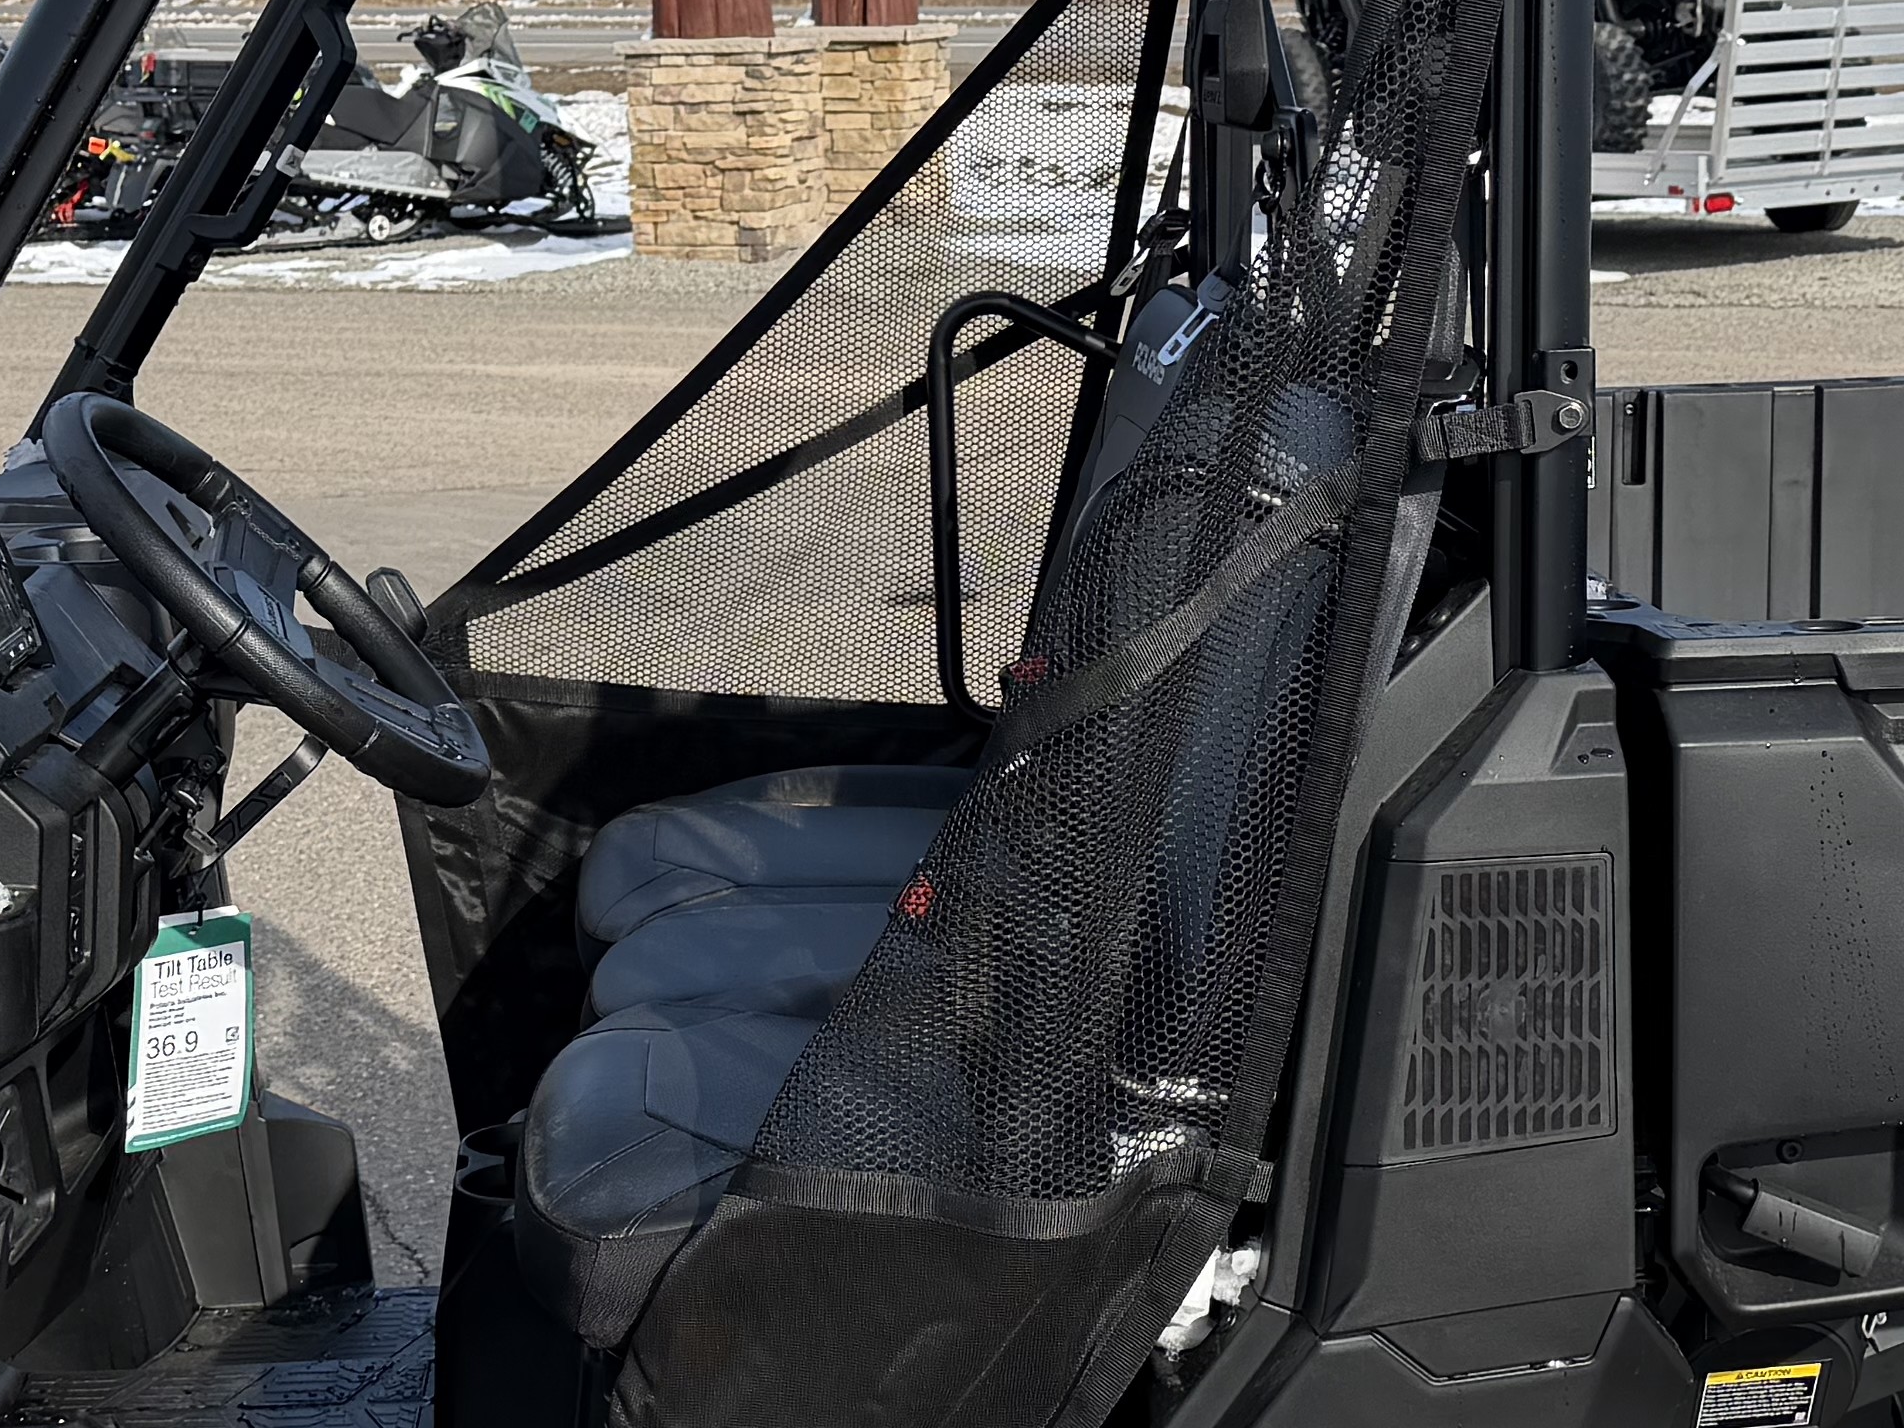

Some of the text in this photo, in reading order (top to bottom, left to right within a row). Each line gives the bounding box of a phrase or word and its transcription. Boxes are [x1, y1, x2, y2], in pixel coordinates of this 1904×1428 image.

[154, 950, 233, 979] Tilt Table
[150, 968, 237, 999] Test Result
[146, 1030, 199, 1060] 36.9
[1745, 1368, 1792, 1380] CAUTION
